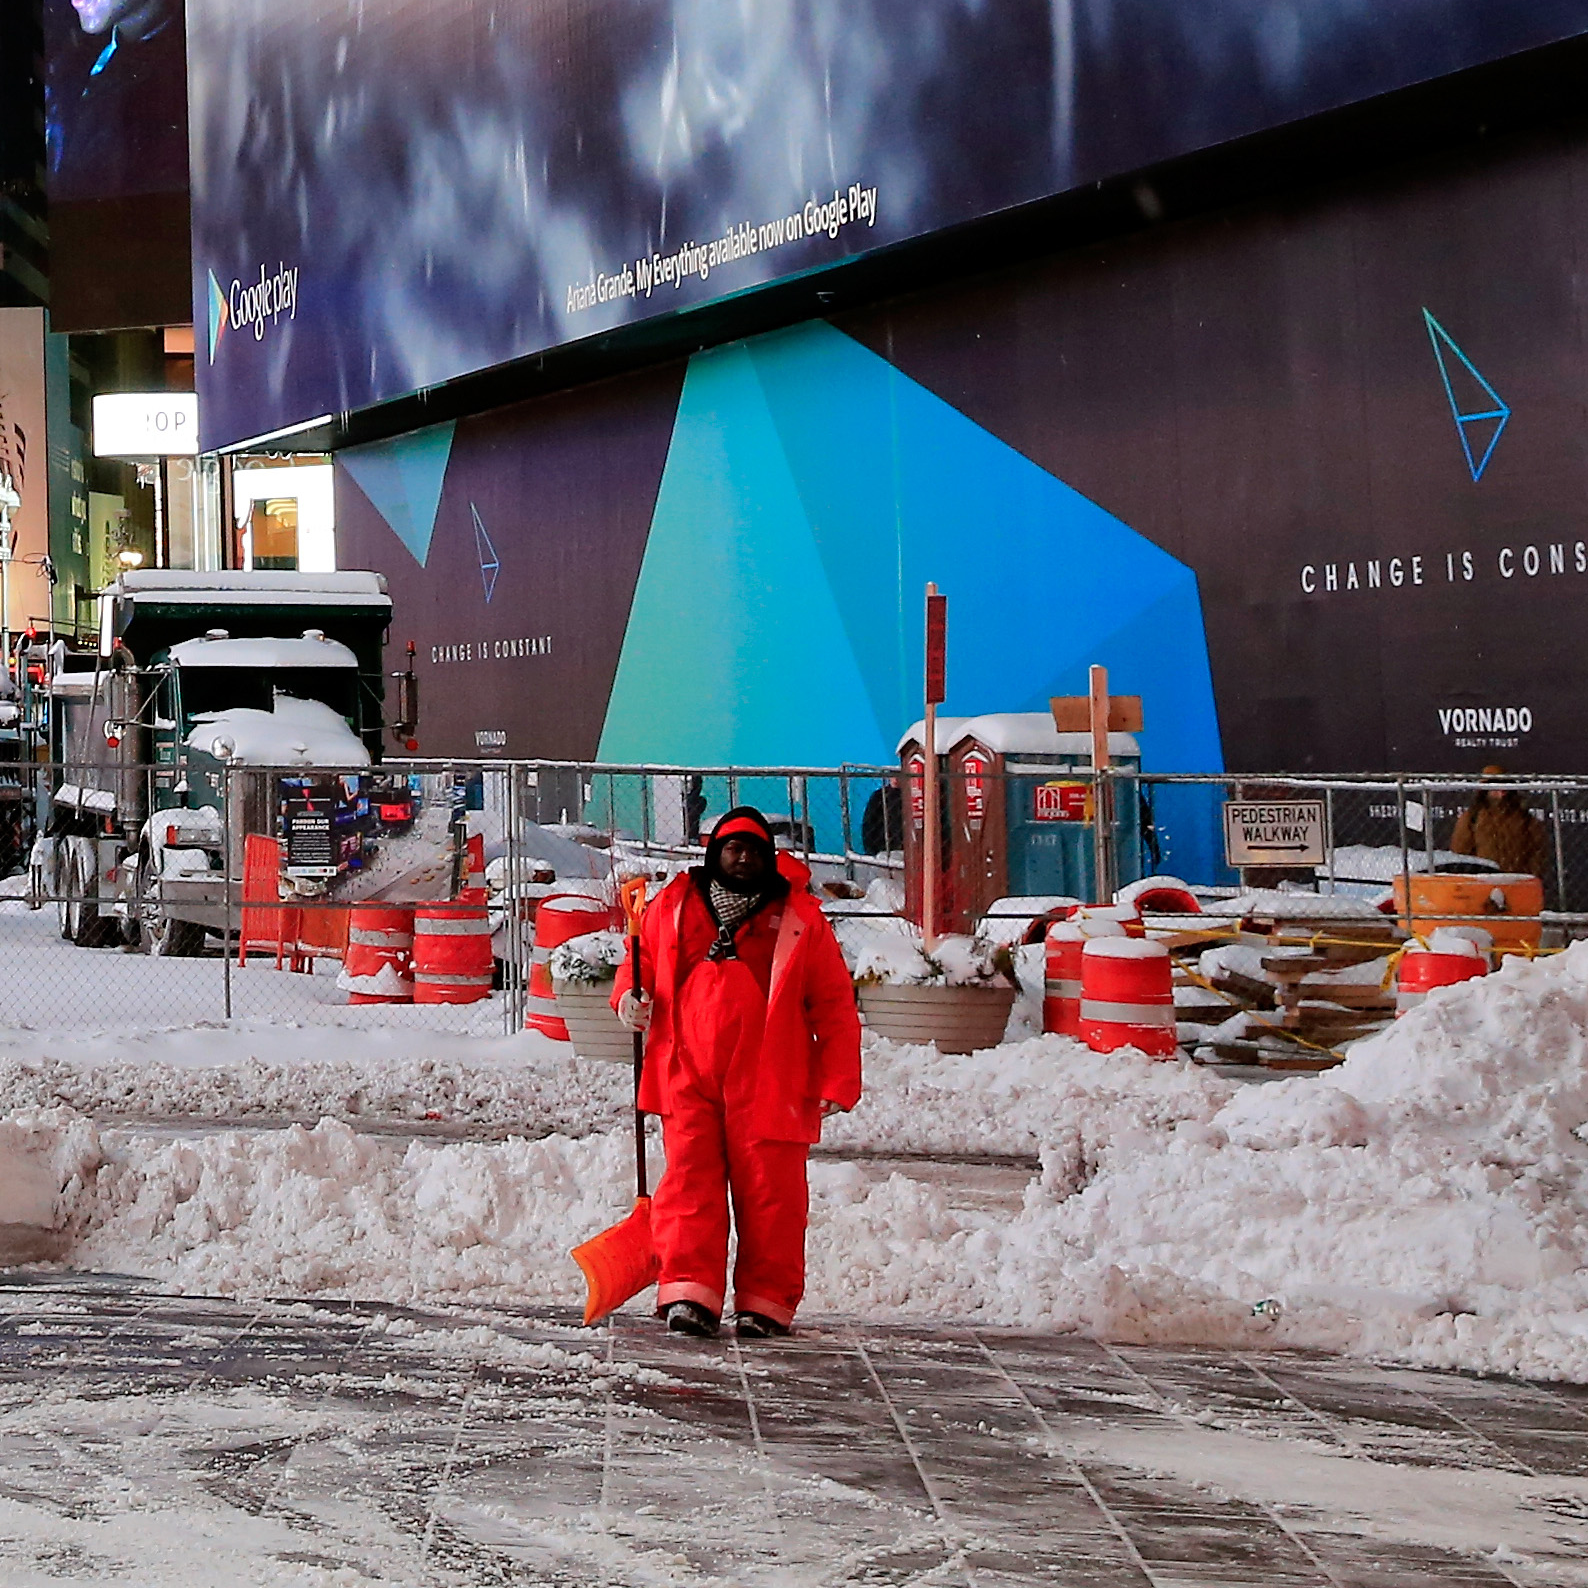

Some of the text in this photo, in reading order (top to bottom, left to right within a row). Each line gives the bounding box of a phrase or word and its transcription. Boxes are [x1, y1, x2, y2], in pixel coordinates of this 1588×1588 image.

[566, 281, 597, 313] Ariana
[636, 258, 653, 298] My
[652, 241, 709, 289] Everything
[709, 221, 758, 268] available
[758, 220, 785, 252] now
[785, 213, 805, 241] on
[804, 191, 848, 240] Google
[849, 182, 877, 228] Play
[229, 261, 298, 341] Google play
[1300, 553, 1423, 594] CHANGE
[1446, 551, 1474, 581] IS
[431, 635, 552, 664] CHANGE IS CONSTANT
[1438, 707, 1533, 735] VORNADO
[1454, 737, 1519, 748] REALTY TRUST
[1231, 808, 1317, 824] PEDESTRIAN
[1242, 825, 1309, 842] WALKWAY
